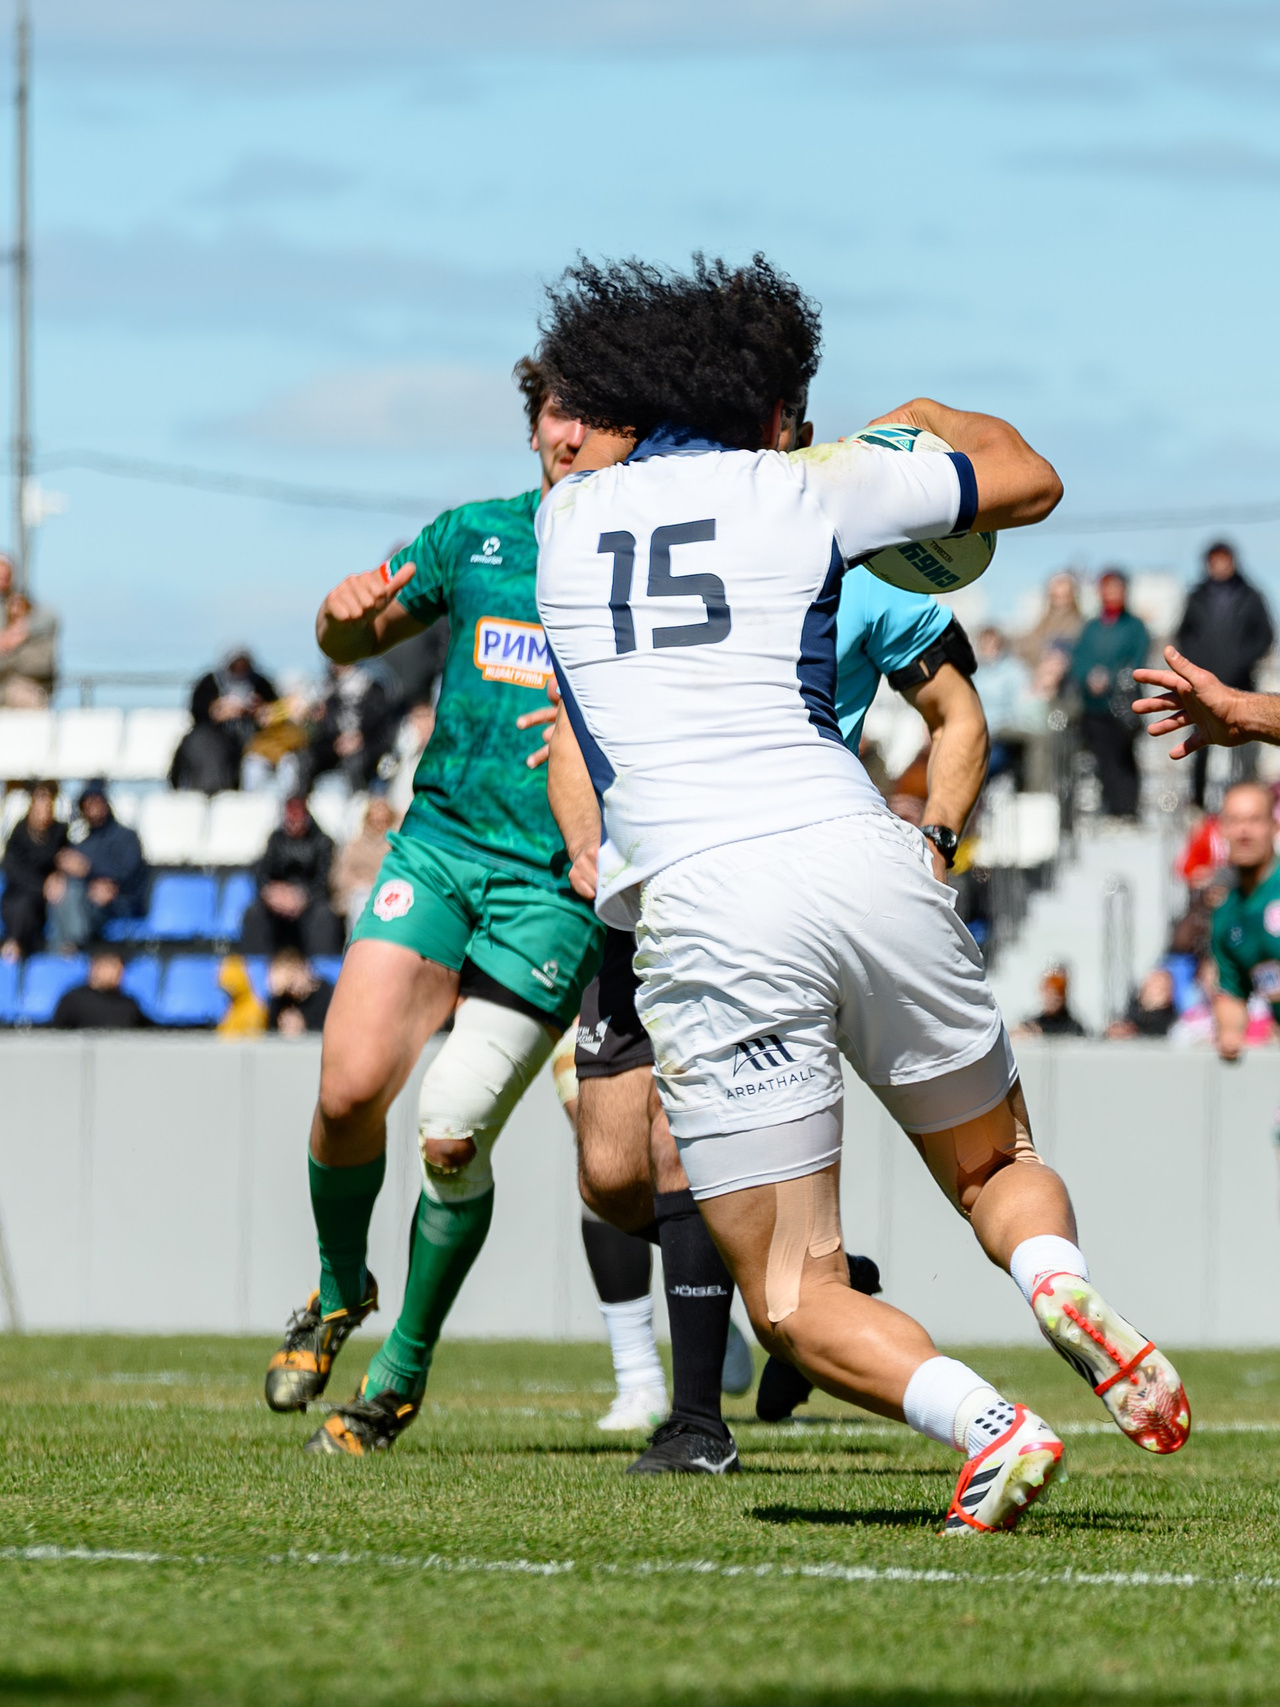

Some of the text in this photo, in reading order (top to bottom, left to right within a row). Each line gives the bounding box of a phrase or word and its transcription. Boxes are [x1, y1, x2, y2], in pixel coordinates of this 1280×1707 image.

[896, 542, 961, 588] СИБУ
[597, 518, 732, 655] 15
[484, 629, 552, 667] РИМ
[727, 1067, 816, 1100] ARBATHALL
